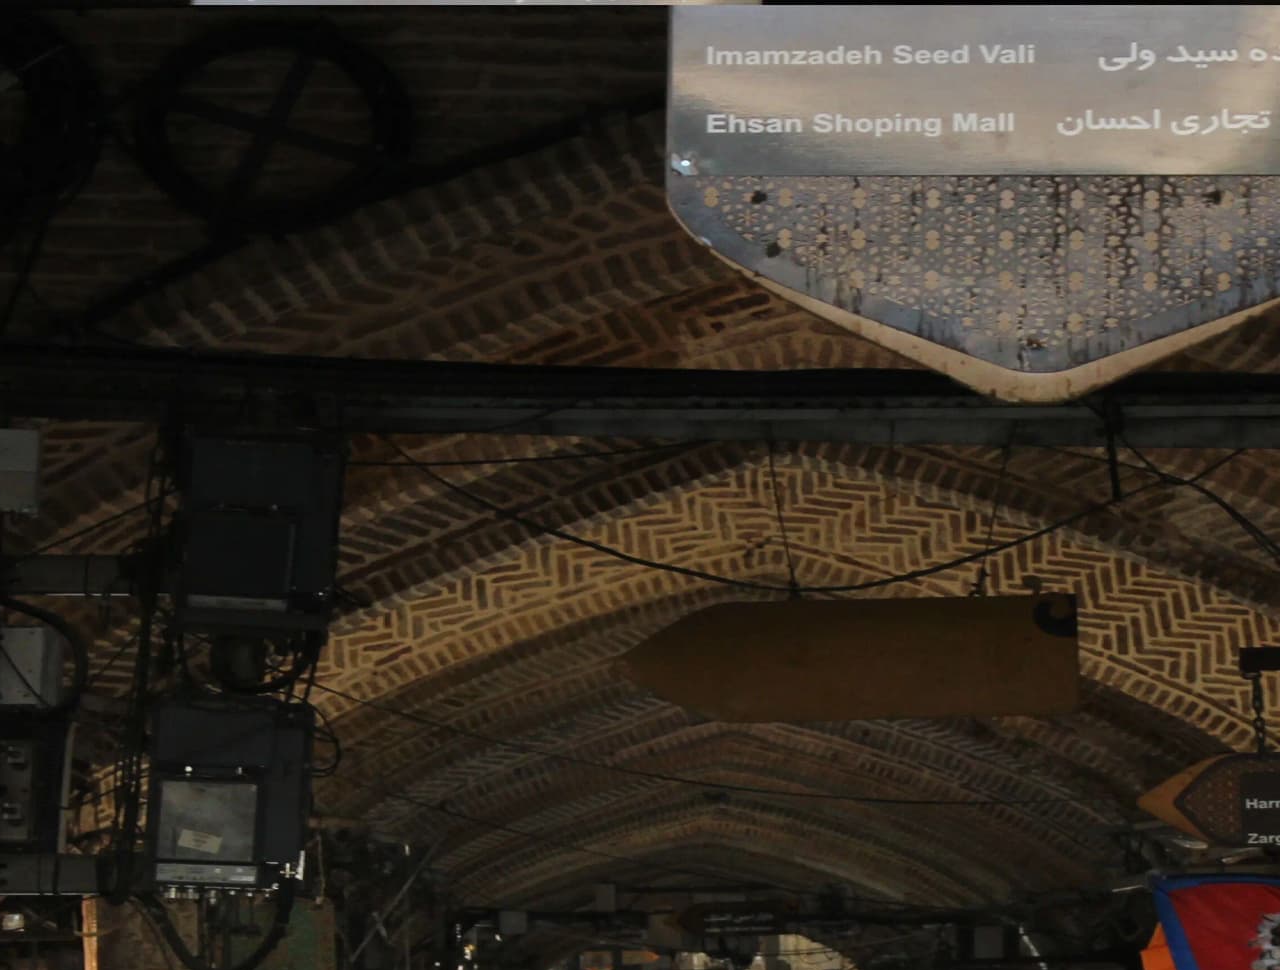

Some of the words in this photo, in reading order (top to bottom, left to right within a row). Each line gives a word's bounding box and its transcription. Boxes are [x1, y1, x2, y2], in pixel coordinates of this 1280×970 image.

[706, 45, 883, 66] Imamzadeh
[892, 44, 970, 65] Seed
[978, 43, 1036, 65] Vali
[1097, 41, 1157, 72] ولی
[1165, 44, 1239, 69] سید
[706, 113, 803, 135] Ehsan
[812, 112, 943, 137] Shoping
[952, 112, 1015, 133] Mall
[1056, 108, 1161, 137] احسان
[1169, 108, 1273, 136] تجاری
